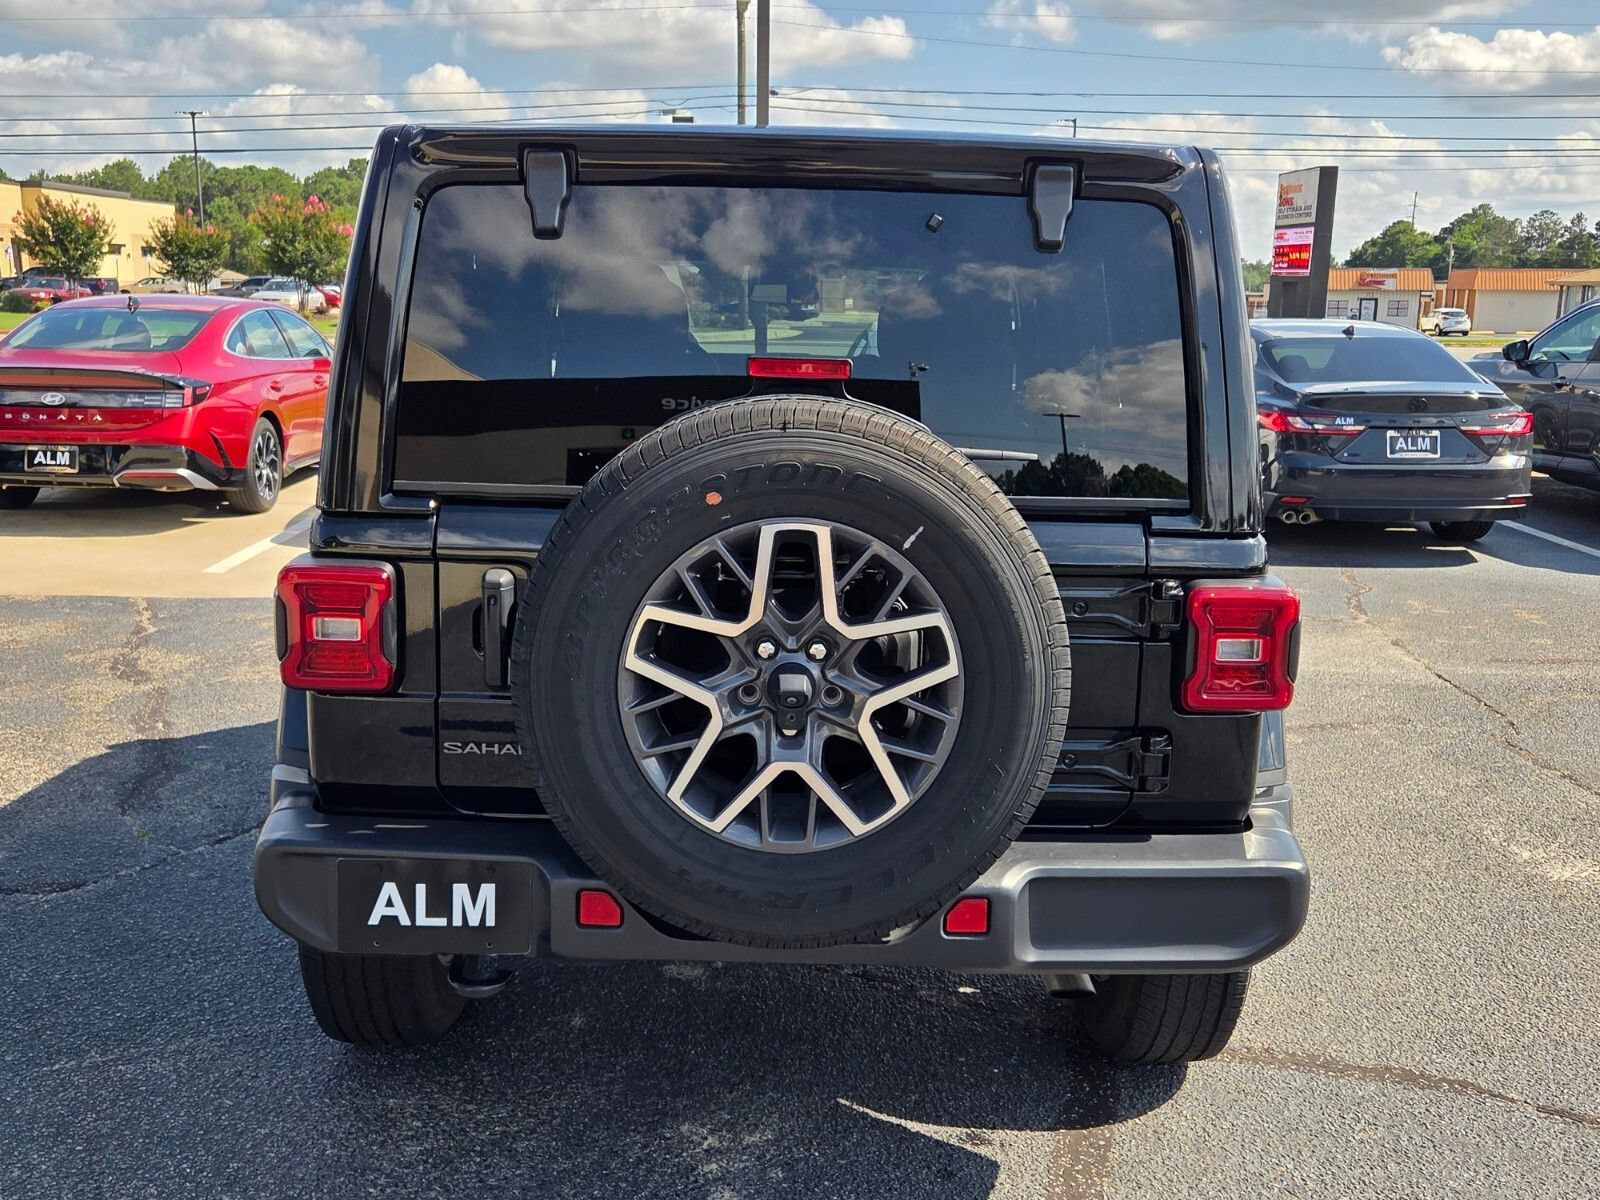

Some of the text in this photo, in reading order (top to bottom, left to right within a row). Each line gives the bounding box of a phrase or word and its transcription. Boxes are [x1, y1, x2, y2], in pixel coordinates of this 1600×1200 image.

[5, 413, 102, 421] SONATA
[1335, 417, 1354, 425] ALM
[1395, 437, 1431, 450] ALM
[33, 451, 70, 465] ALM
[443, 742, 522, 756] SAHA
[367, 881, 496, 927] ALM
